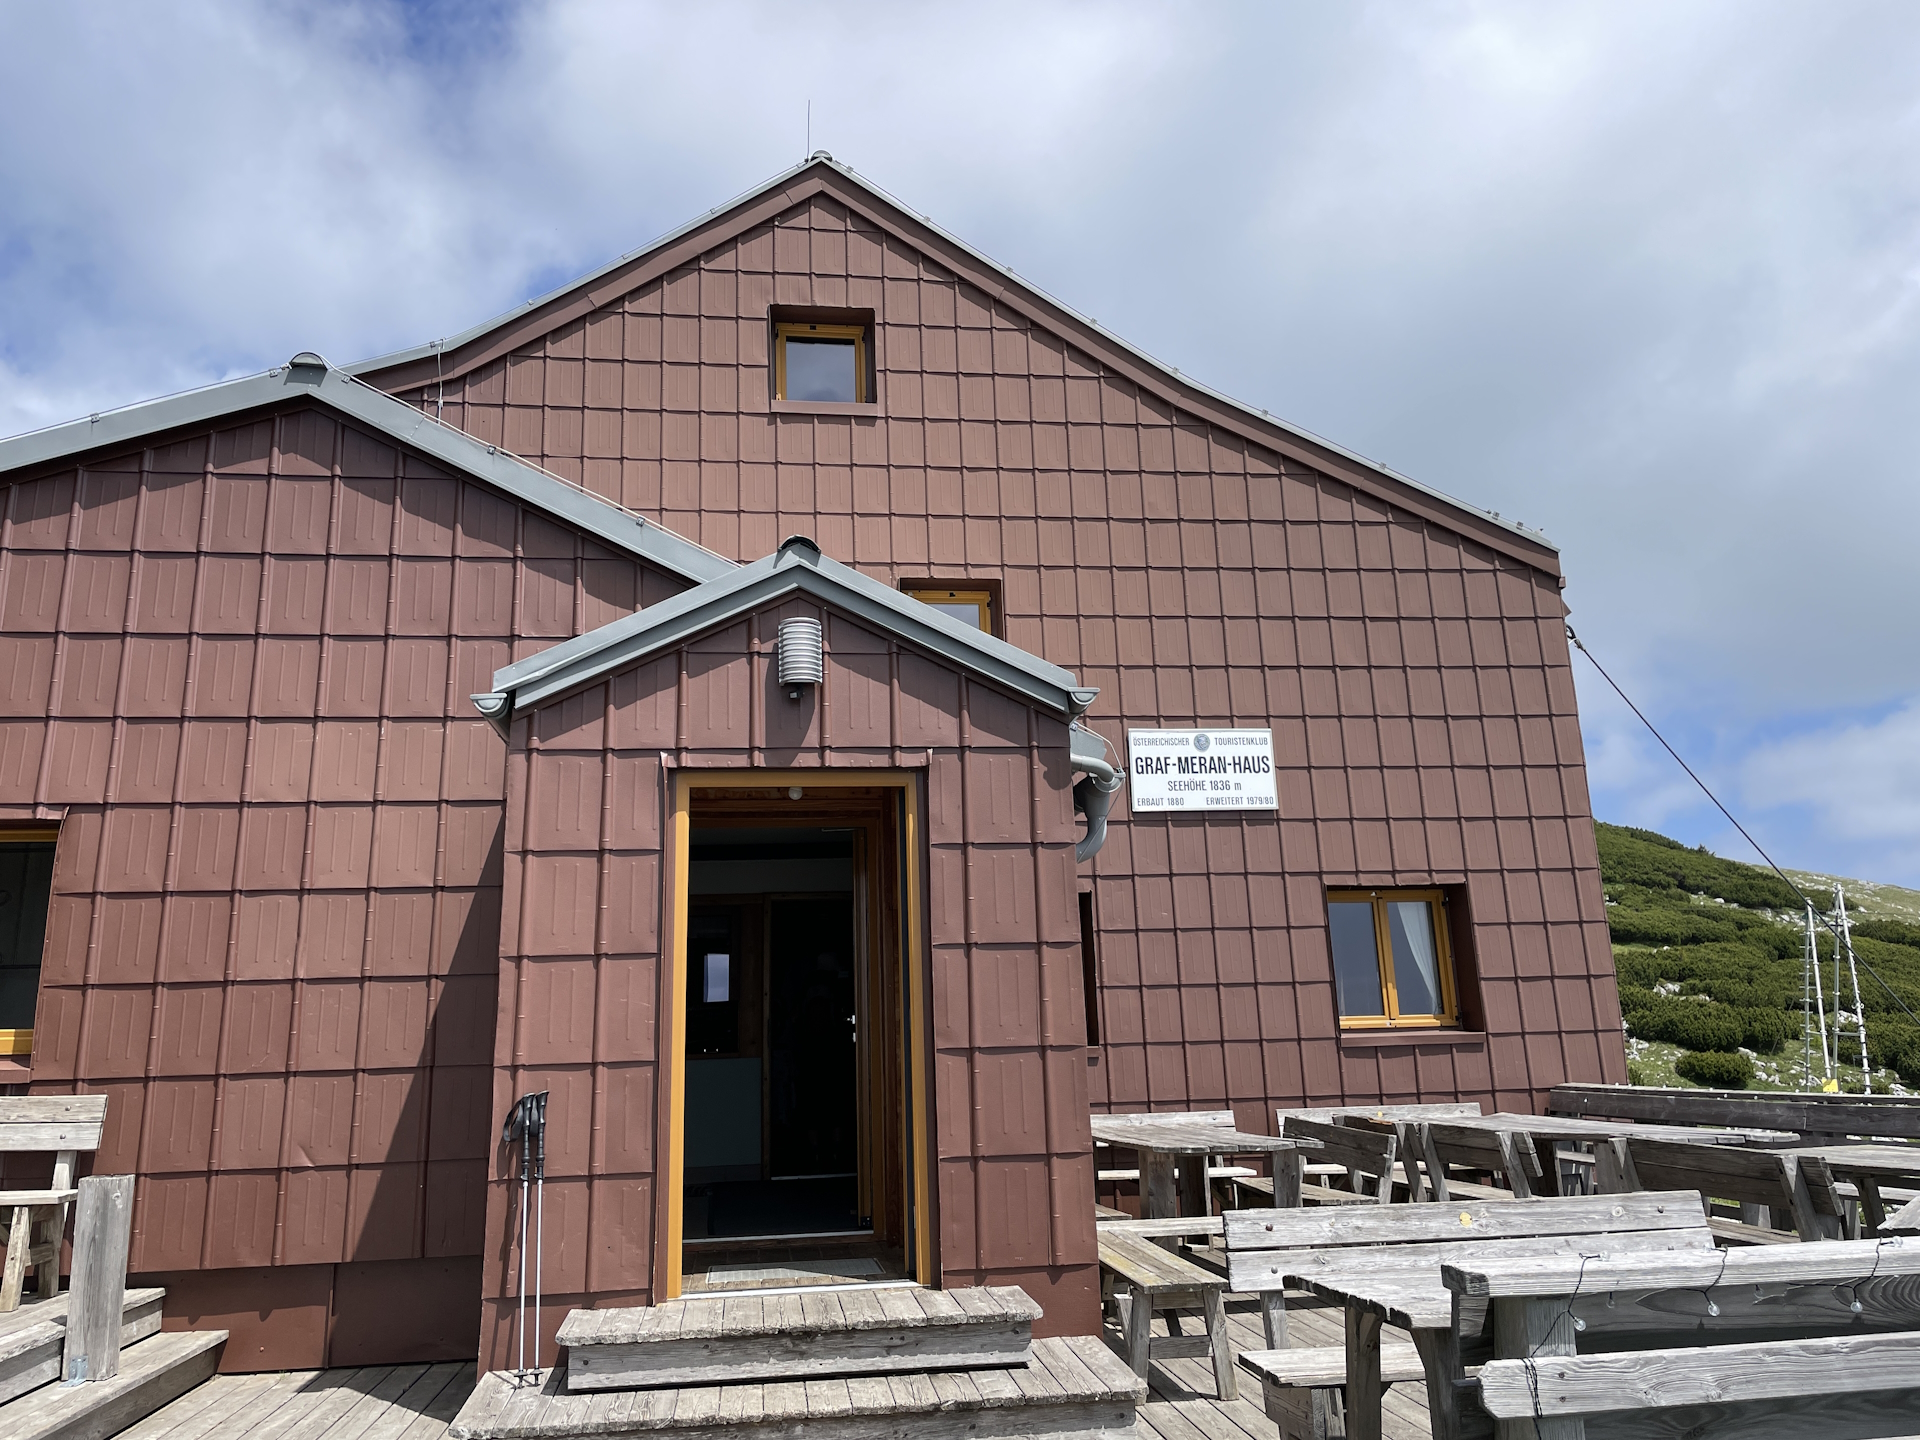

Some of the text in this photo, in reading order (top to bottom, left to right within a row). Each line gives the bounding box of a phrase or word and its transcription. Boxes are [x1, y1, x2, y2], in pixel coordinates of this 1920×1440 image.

[1133, 737, 1268, 746] ÖSTERREICHISCHER TOURISTENKLUB
[1135, 755, 1271, 775] GRAF-MERAN-HAUS
[1167, 778, 1242, 791] SEEHÖHE 1836 m
[1137, 796, 1274, 807] ERBAUT 1880 ERWEITERT 1979/80
